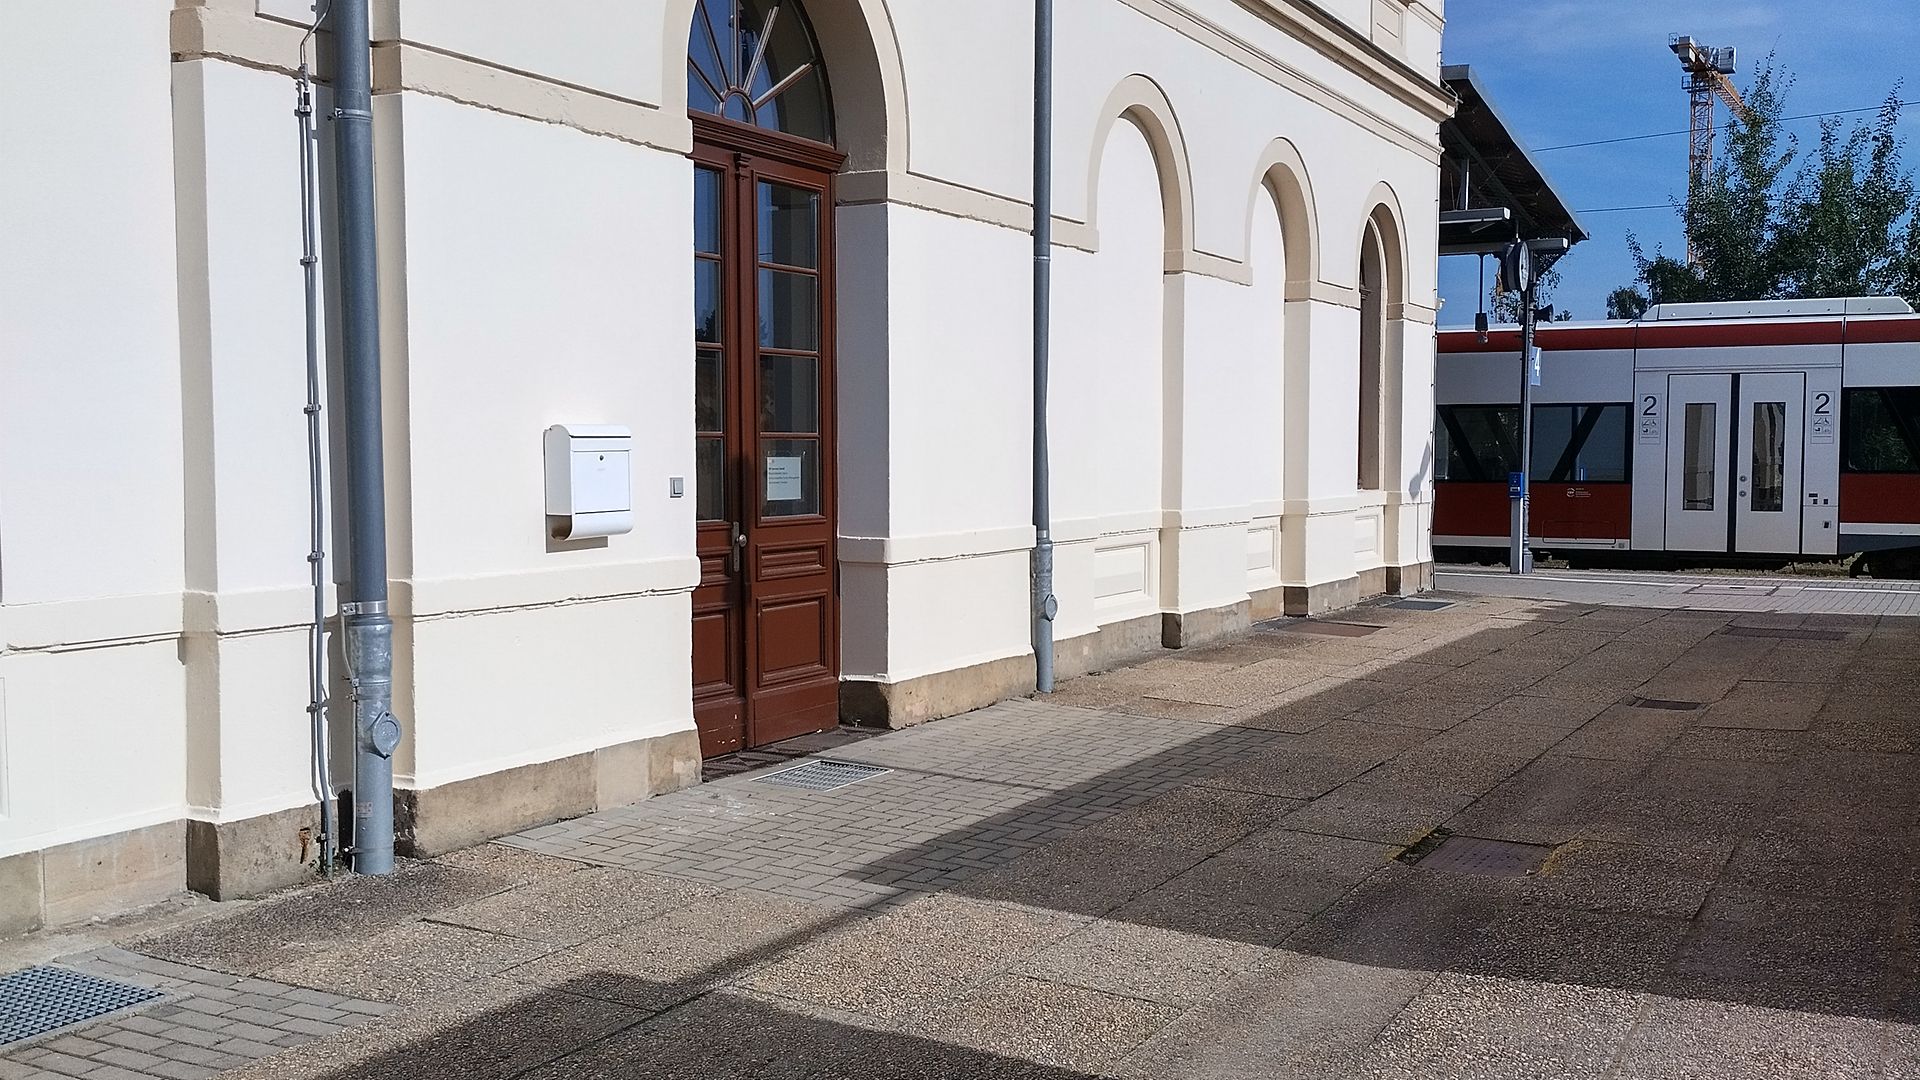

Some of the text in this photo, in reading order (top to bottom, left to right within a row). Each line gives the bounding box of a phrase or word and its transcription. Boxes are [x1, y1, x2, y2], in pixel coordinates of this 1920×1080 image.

[1535, 349, 1541, 377] 4
[1643, 395, 1657, 416] 2
[1815, 393, 1830, 414] 2
